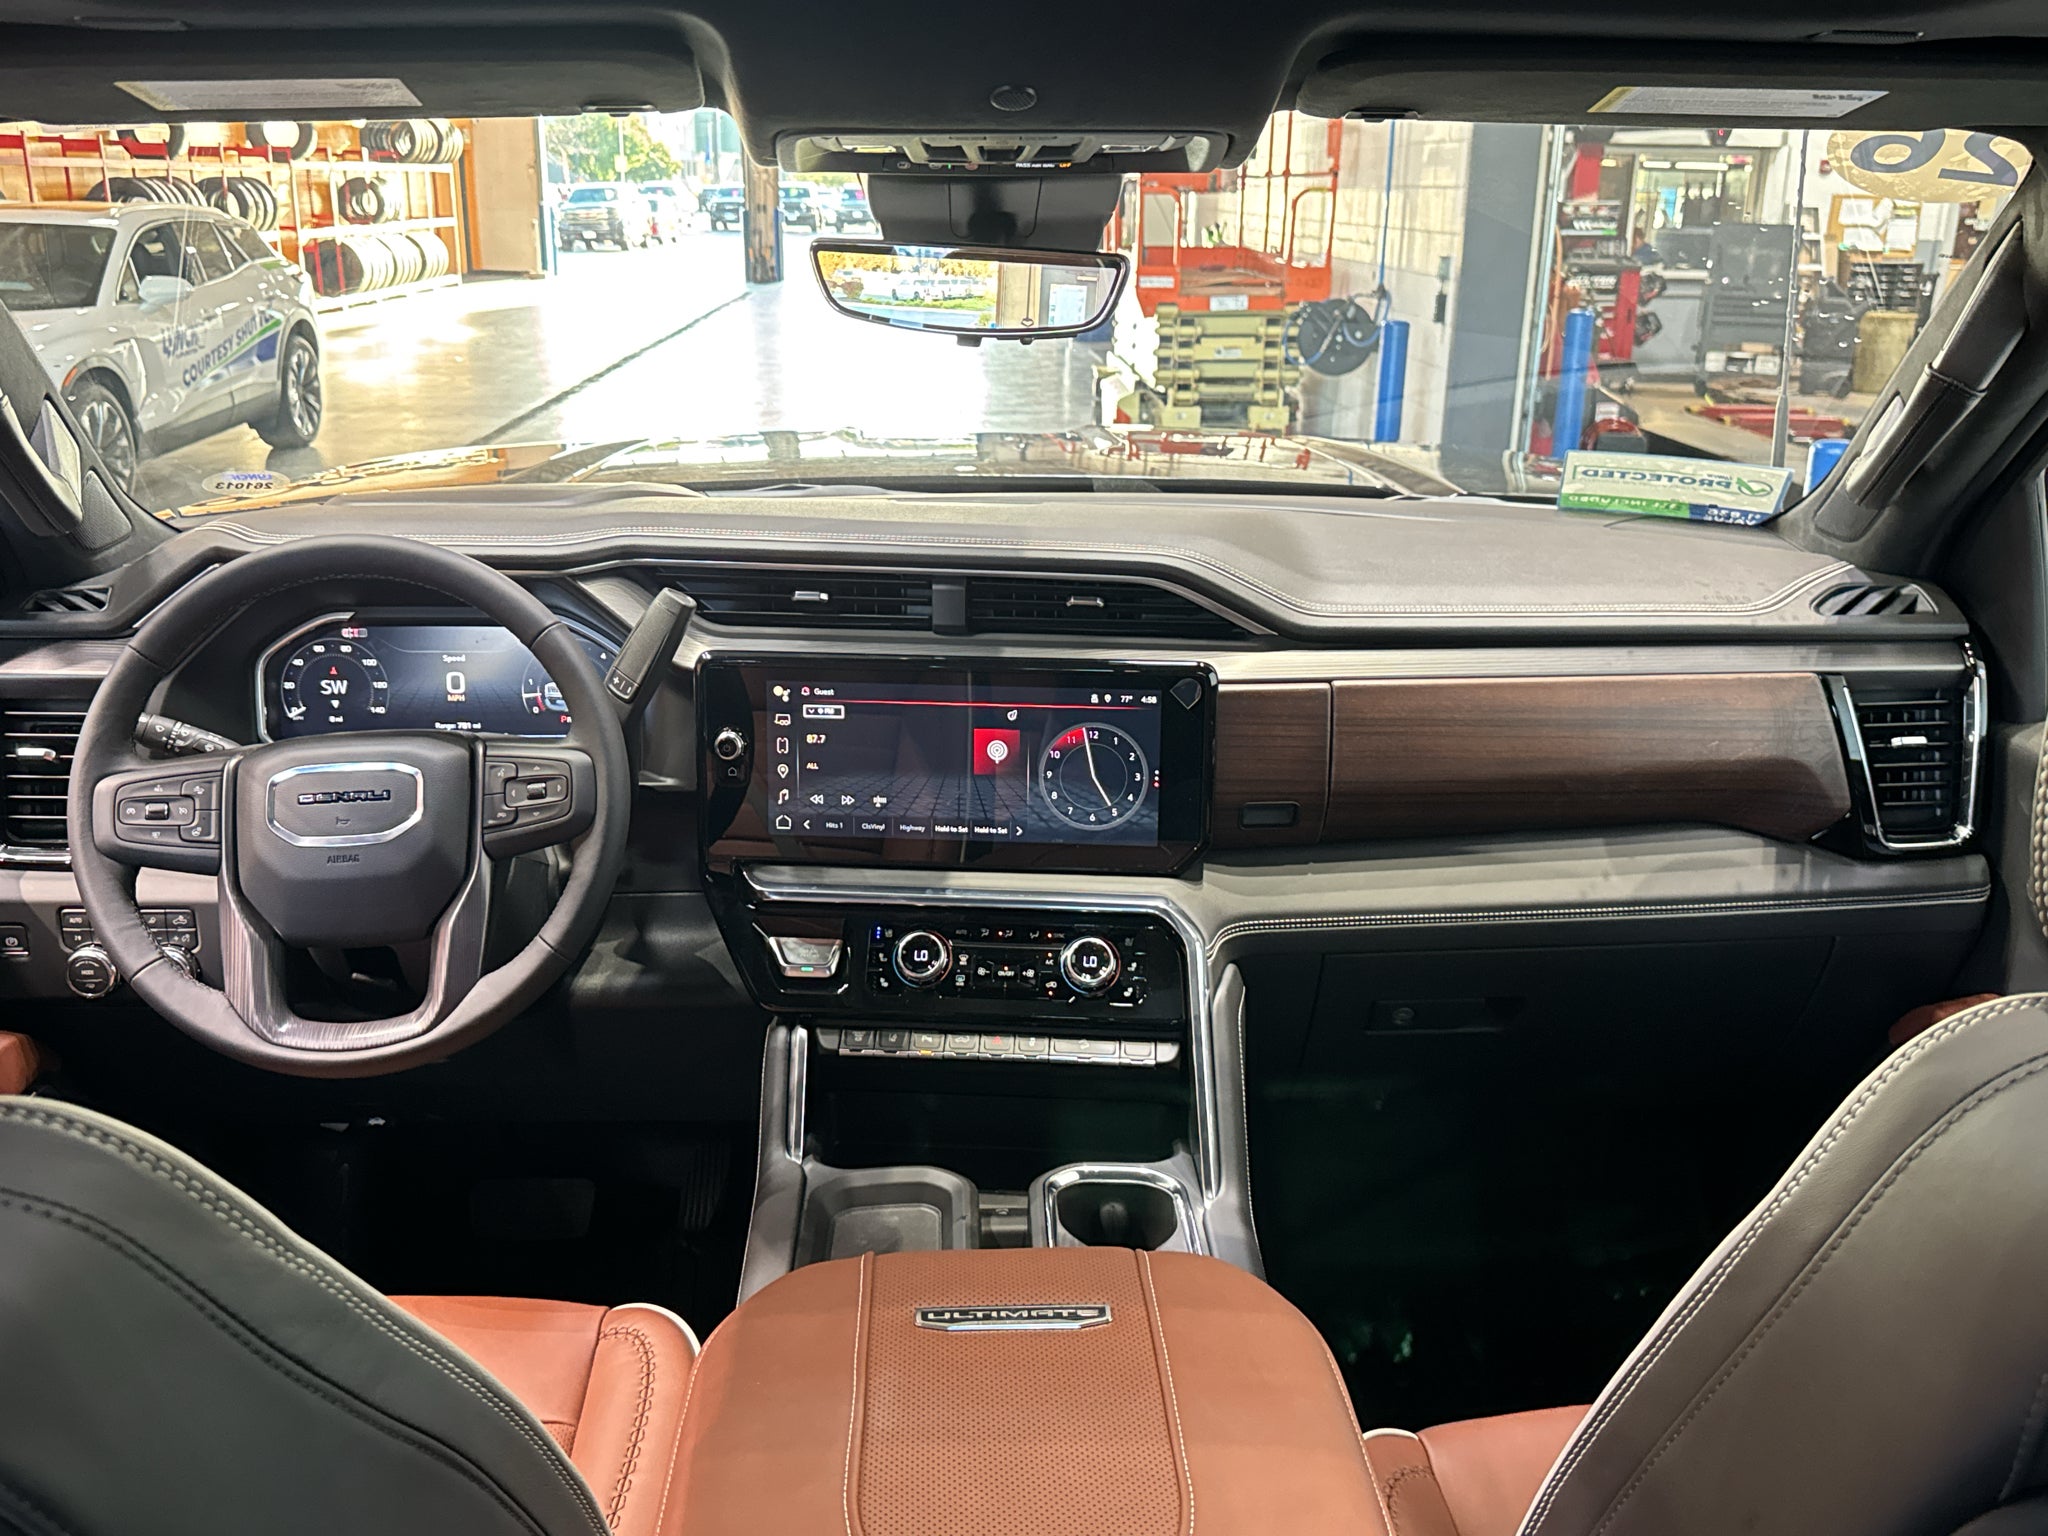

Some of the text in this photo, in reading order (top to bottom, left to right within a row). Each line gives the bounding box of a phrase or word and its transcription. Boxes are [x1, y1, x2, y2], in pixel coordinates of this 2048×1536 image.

[183, 334, 236, 387] COURTESY
[446, 671, 466, 694] 0
[320, 680, 348, 695] SW
[814, 687, 835, 696] Guest
[1141, 696, 1158, 704] 4:58
[806, 734, 826, 744] 87.7
[1089, 731, 1099, 739] 12
[1050, 751, 1060, 759] 10
[1129, 753, 1135, 761] 2
[806, 762, 819, 770] ALL
[1046, 771, 1052, 779] 9
[1135, 772, 1141, 781] 3
[297, 789, 391, 805] DENALI
[1051, 791, 1058, 799] 8
[1127, 793, 1134, 801] 4
[1067, 807, 1073, 815] 7
[1089, 813, 1096, 821] 6
[900, 824, 925, 833] Highway
[935, 825, 950, 833] Hold
[958, 825, 968, 833] Set
[974, 826, 989, 834] Hold
[997, 826, 1008, 835] Set
[326, 853, 360, 864] AIRBAG
[914, 950, 928, 961] LO
[1083, 955, 1098, 968] LO
[927, 1309, 1100, 1320] ULTIMATE
